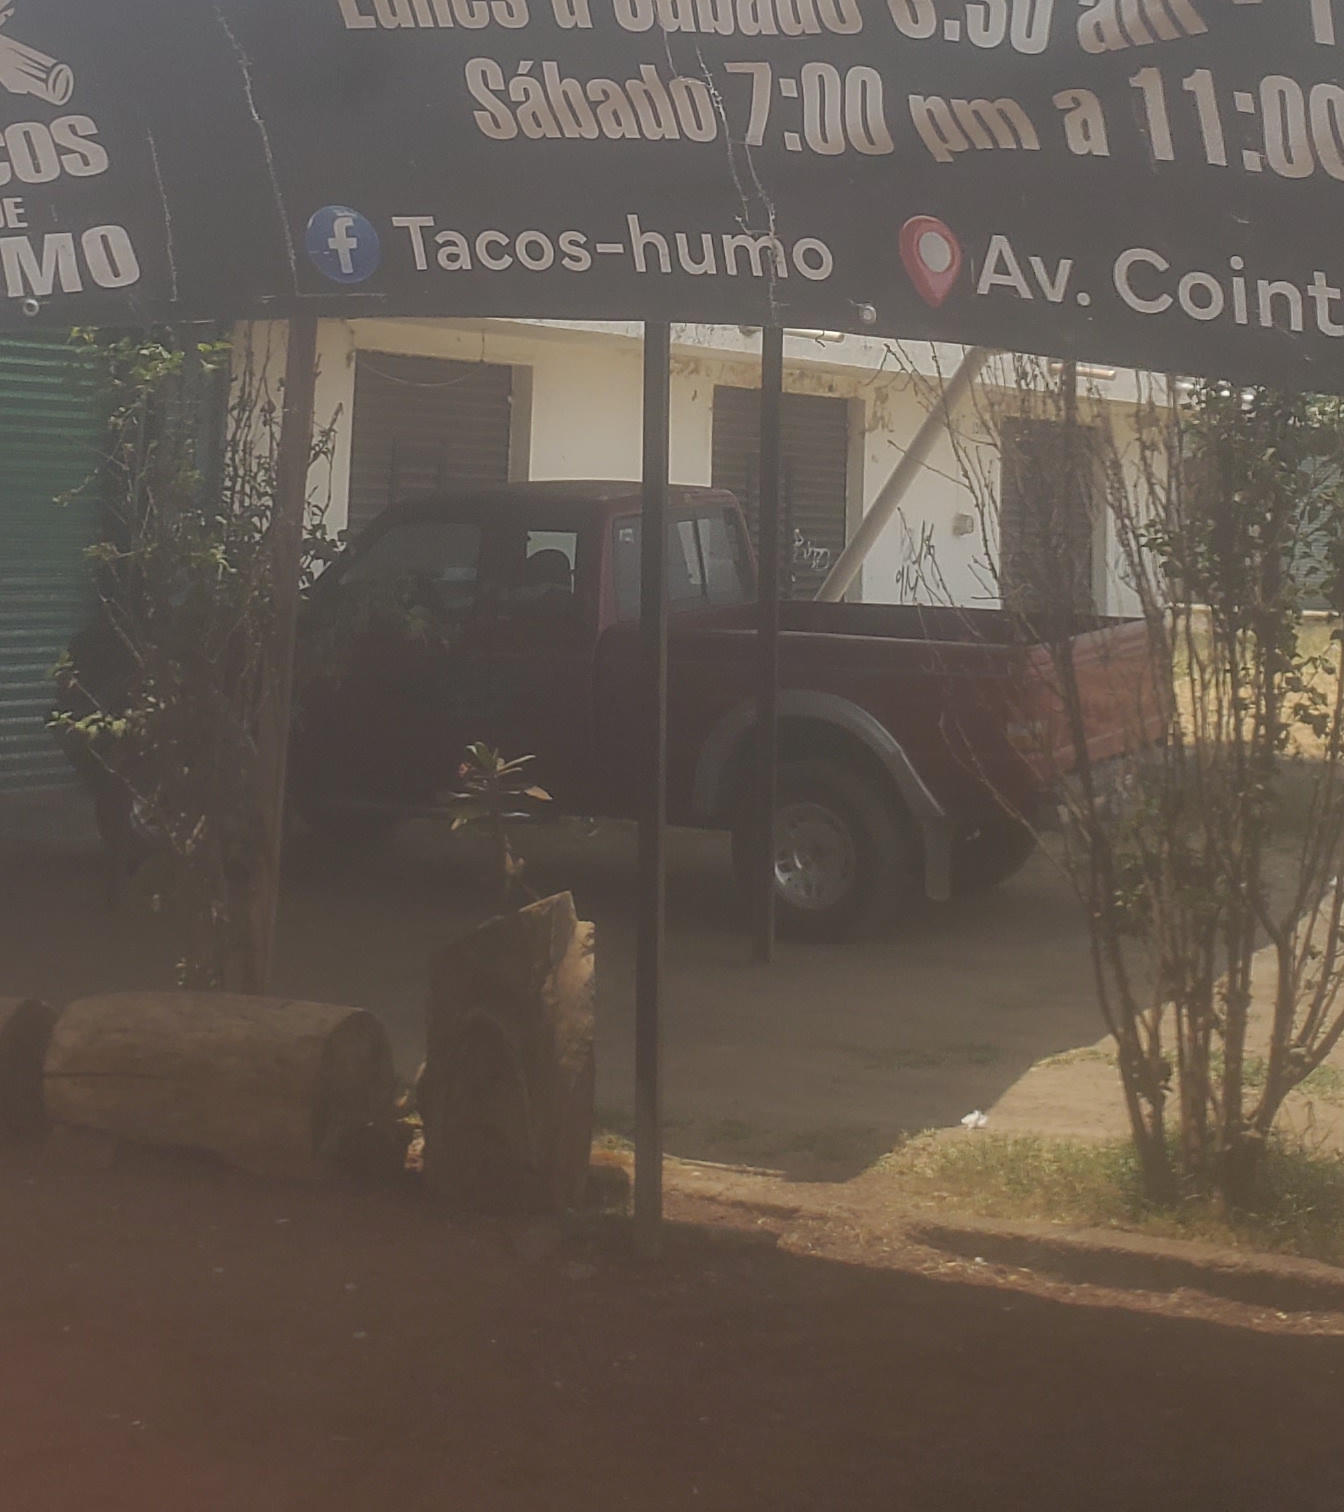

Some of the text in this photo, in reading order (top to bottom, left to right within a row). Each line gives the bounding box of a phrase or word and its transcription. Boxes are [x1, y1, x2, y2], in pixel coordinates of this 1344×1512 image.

[464, 57, 719, 144] Sábado
[723, 61, 895, 157] 7:00
[908, 92, 1041, 164] pm
[1052, 88, 1110, 158] a
[391, 214, 834, 282] Tacos-humo
[976, 233, 1092, 308] Av.
